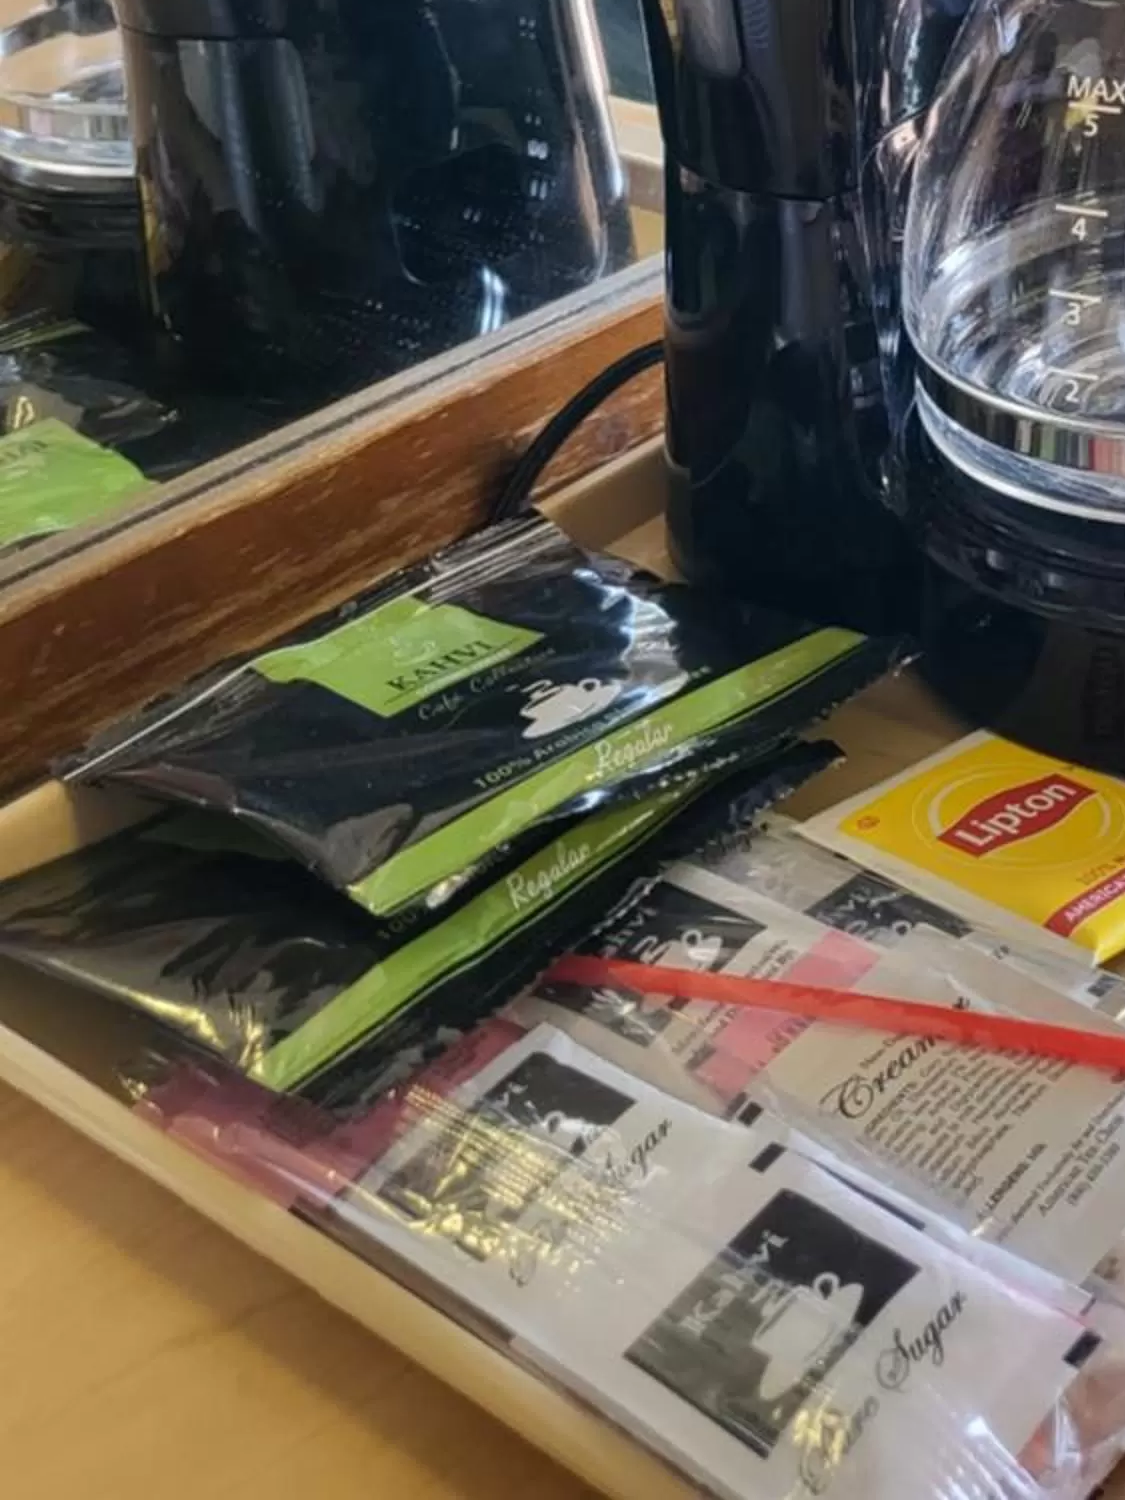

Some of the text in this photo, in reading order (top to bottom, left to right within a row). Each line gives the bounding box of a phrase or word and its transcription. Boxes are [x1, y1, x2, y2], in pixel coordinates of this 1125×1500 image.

[1082, 113, 1100, 138] 5
[1070, 215, 1087, 241] 4
[1066, 301, 1081, 326] 3
[1064, 379, 1080, 402] 2
[384, 639, 493, 692] KAHVI
[954, 782, 1077, 847] Lipton
[505, 840, 592, 911] Regular
[875, 1290, 968, 1393] Sugar
